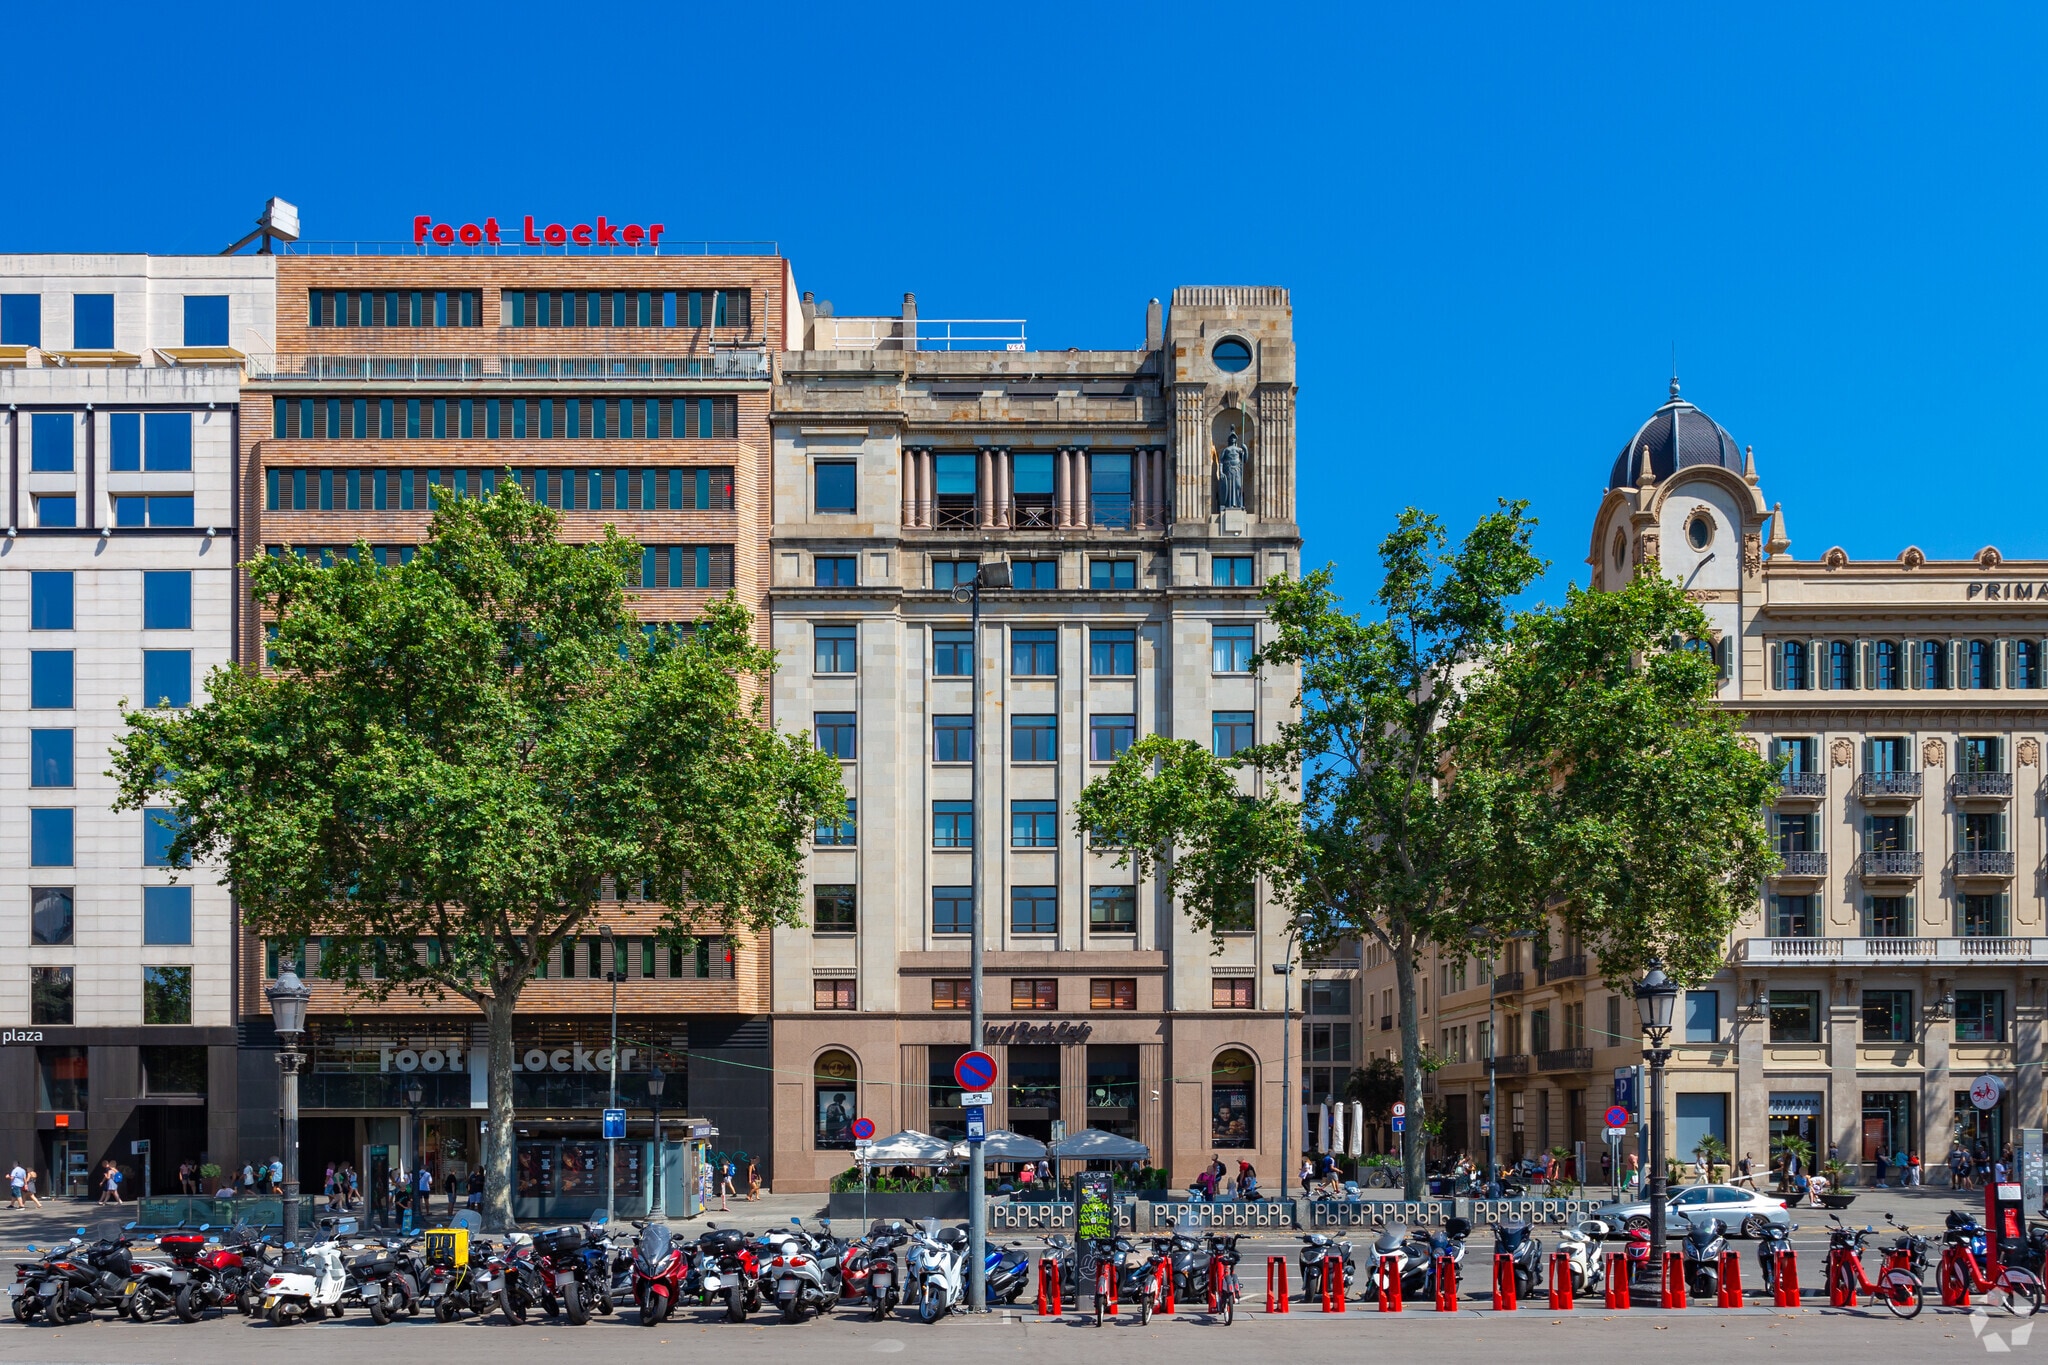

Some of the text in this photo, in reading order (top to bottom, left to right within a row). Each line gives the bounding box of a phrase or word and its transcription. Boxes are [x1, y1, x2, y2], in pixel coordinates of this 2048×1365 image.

[413, 215, 665, 247] Foot Locker
[2, 1028, 43, 1045] plaza
[379, 1041, 464, 1072] Foot
[1620, 1079, 1627, 1100] P
